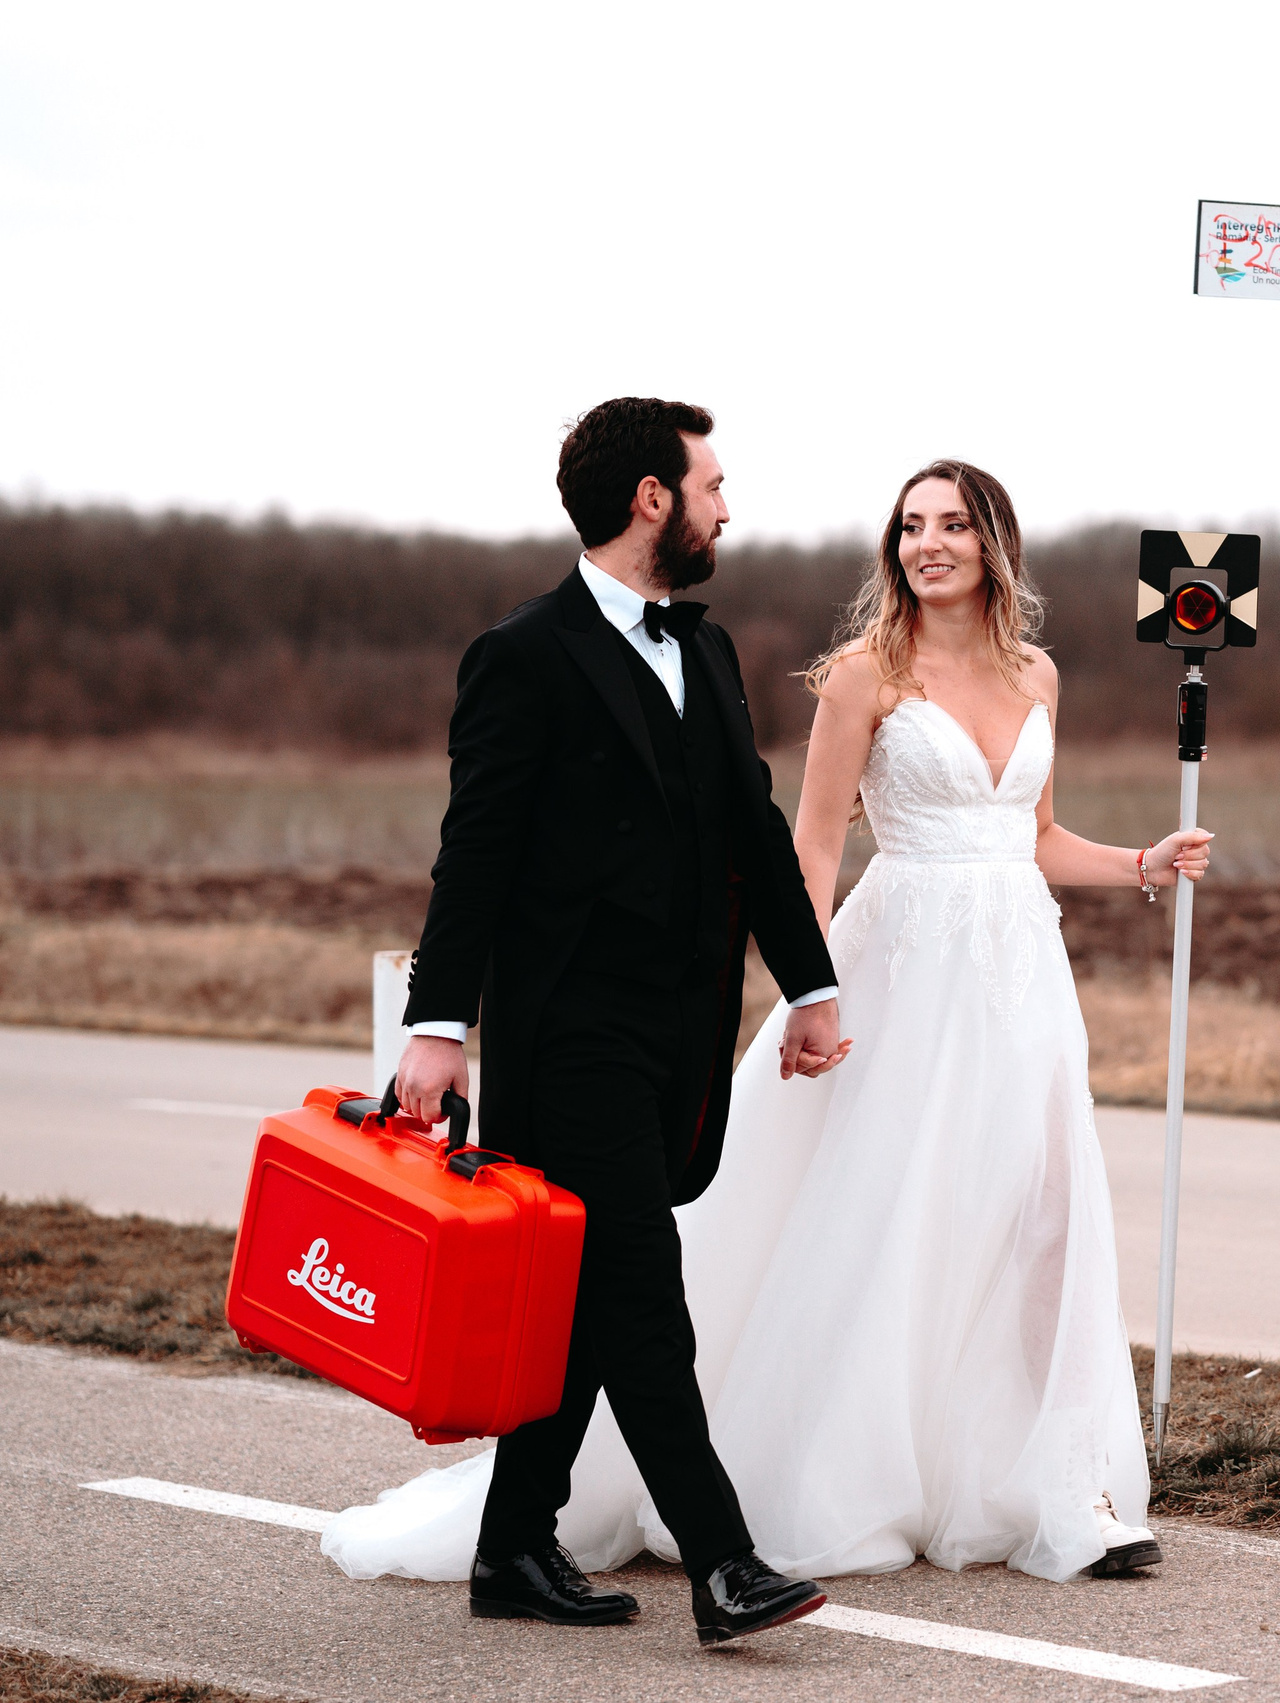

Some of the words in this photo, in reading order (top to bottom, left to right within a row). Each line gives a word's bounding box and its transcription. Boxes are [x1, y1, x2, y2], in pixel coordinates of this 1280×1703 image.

[1216, 220, 1264, 233] Interreg
[1252, 276, 1264, 284] Un
[286, 1237, 376, 1325] Leica
